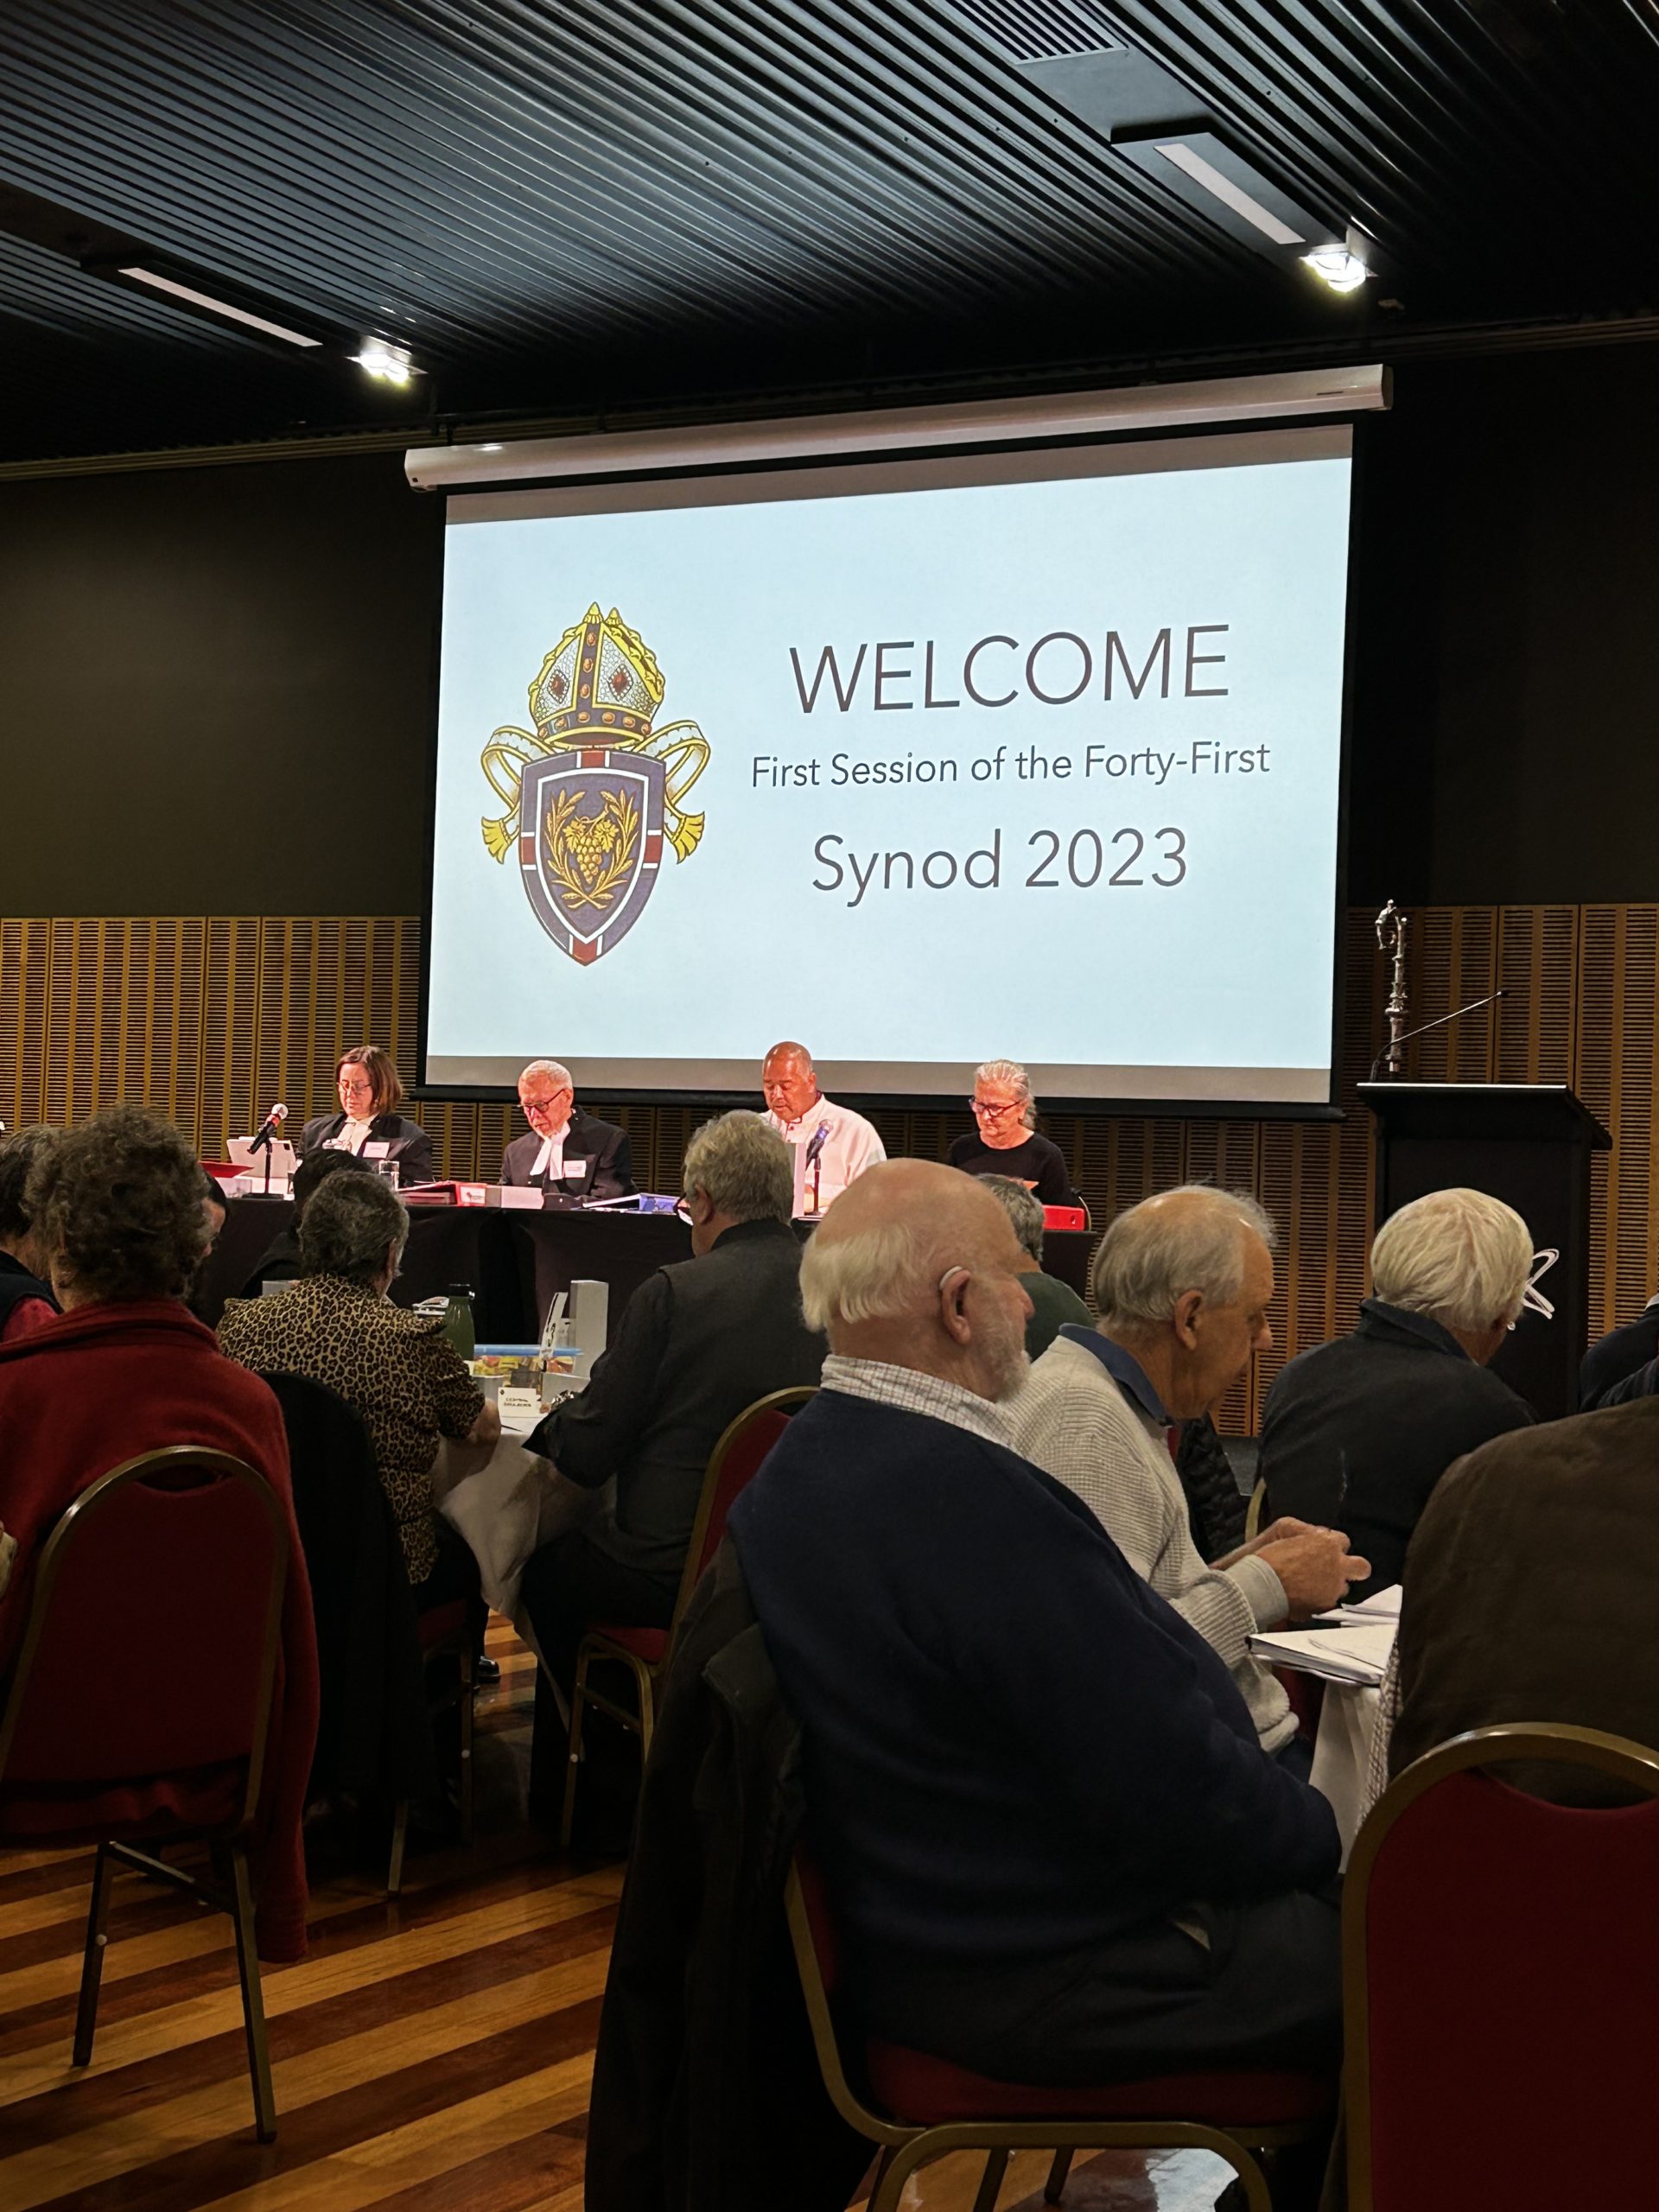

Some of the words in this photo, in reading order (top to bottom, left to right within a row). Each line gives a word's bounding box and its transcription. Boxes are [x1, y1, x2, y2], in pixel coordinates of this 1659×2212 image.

[789, 624, 1230, 714] WELCOME
[752, 754, 821, 788] First
[830, 752, 957, 785] Session
[970, 746, 1007, 781] of
[1014, 745, 1072, 779] the
[1085, 741, 1271, 785] Forty-First
[812, 828, 1001, 908] Synod
[1025, 827, 1187, 889] 2023
